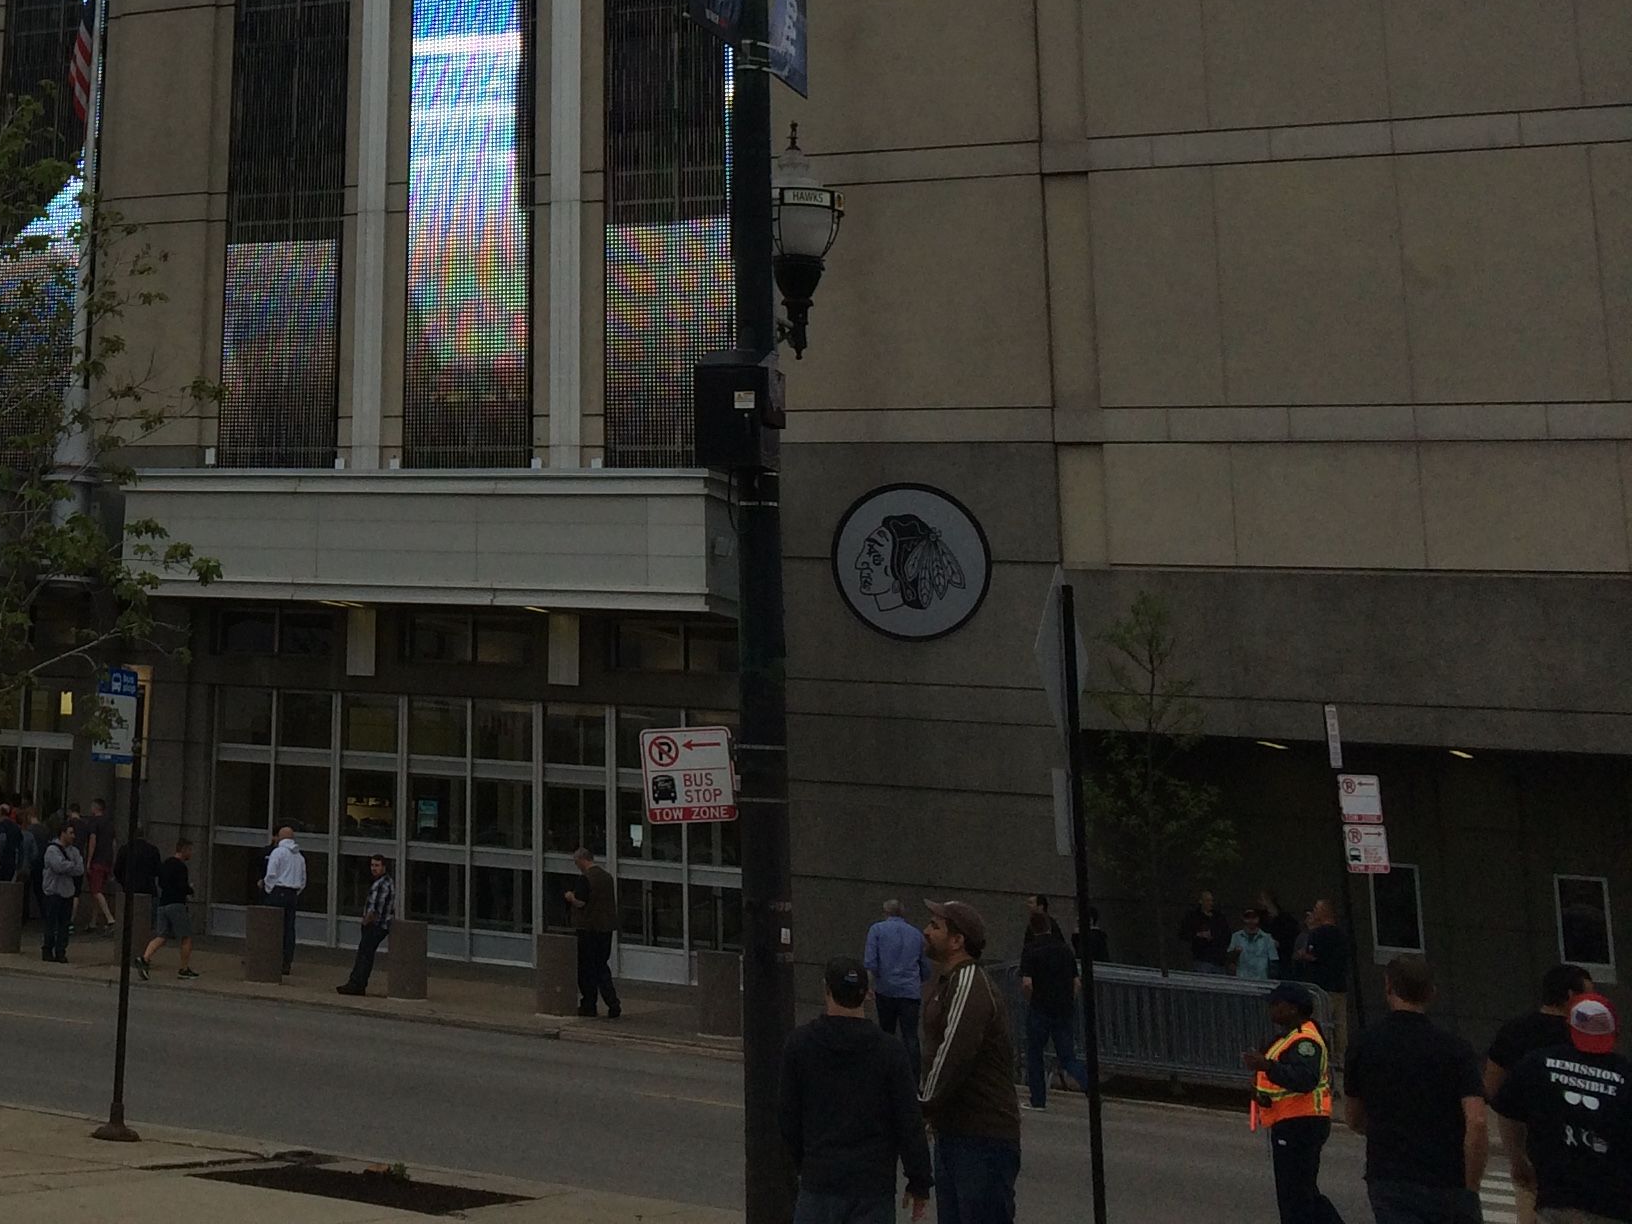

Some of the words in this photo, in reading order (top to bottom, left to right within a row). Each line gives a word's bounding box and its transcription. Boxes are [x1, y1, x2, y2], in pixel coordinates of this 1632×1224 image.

[792, 191, 824, 203] HAWKS
[682, 772, 713, 787] BUS
[684, 788, 722, 803] STOP
[654, 809, 683, 821] TOW
[691, 806, 729, 819] ZONE
[1549, 1072, 1617, 1097] POSSIBLE
